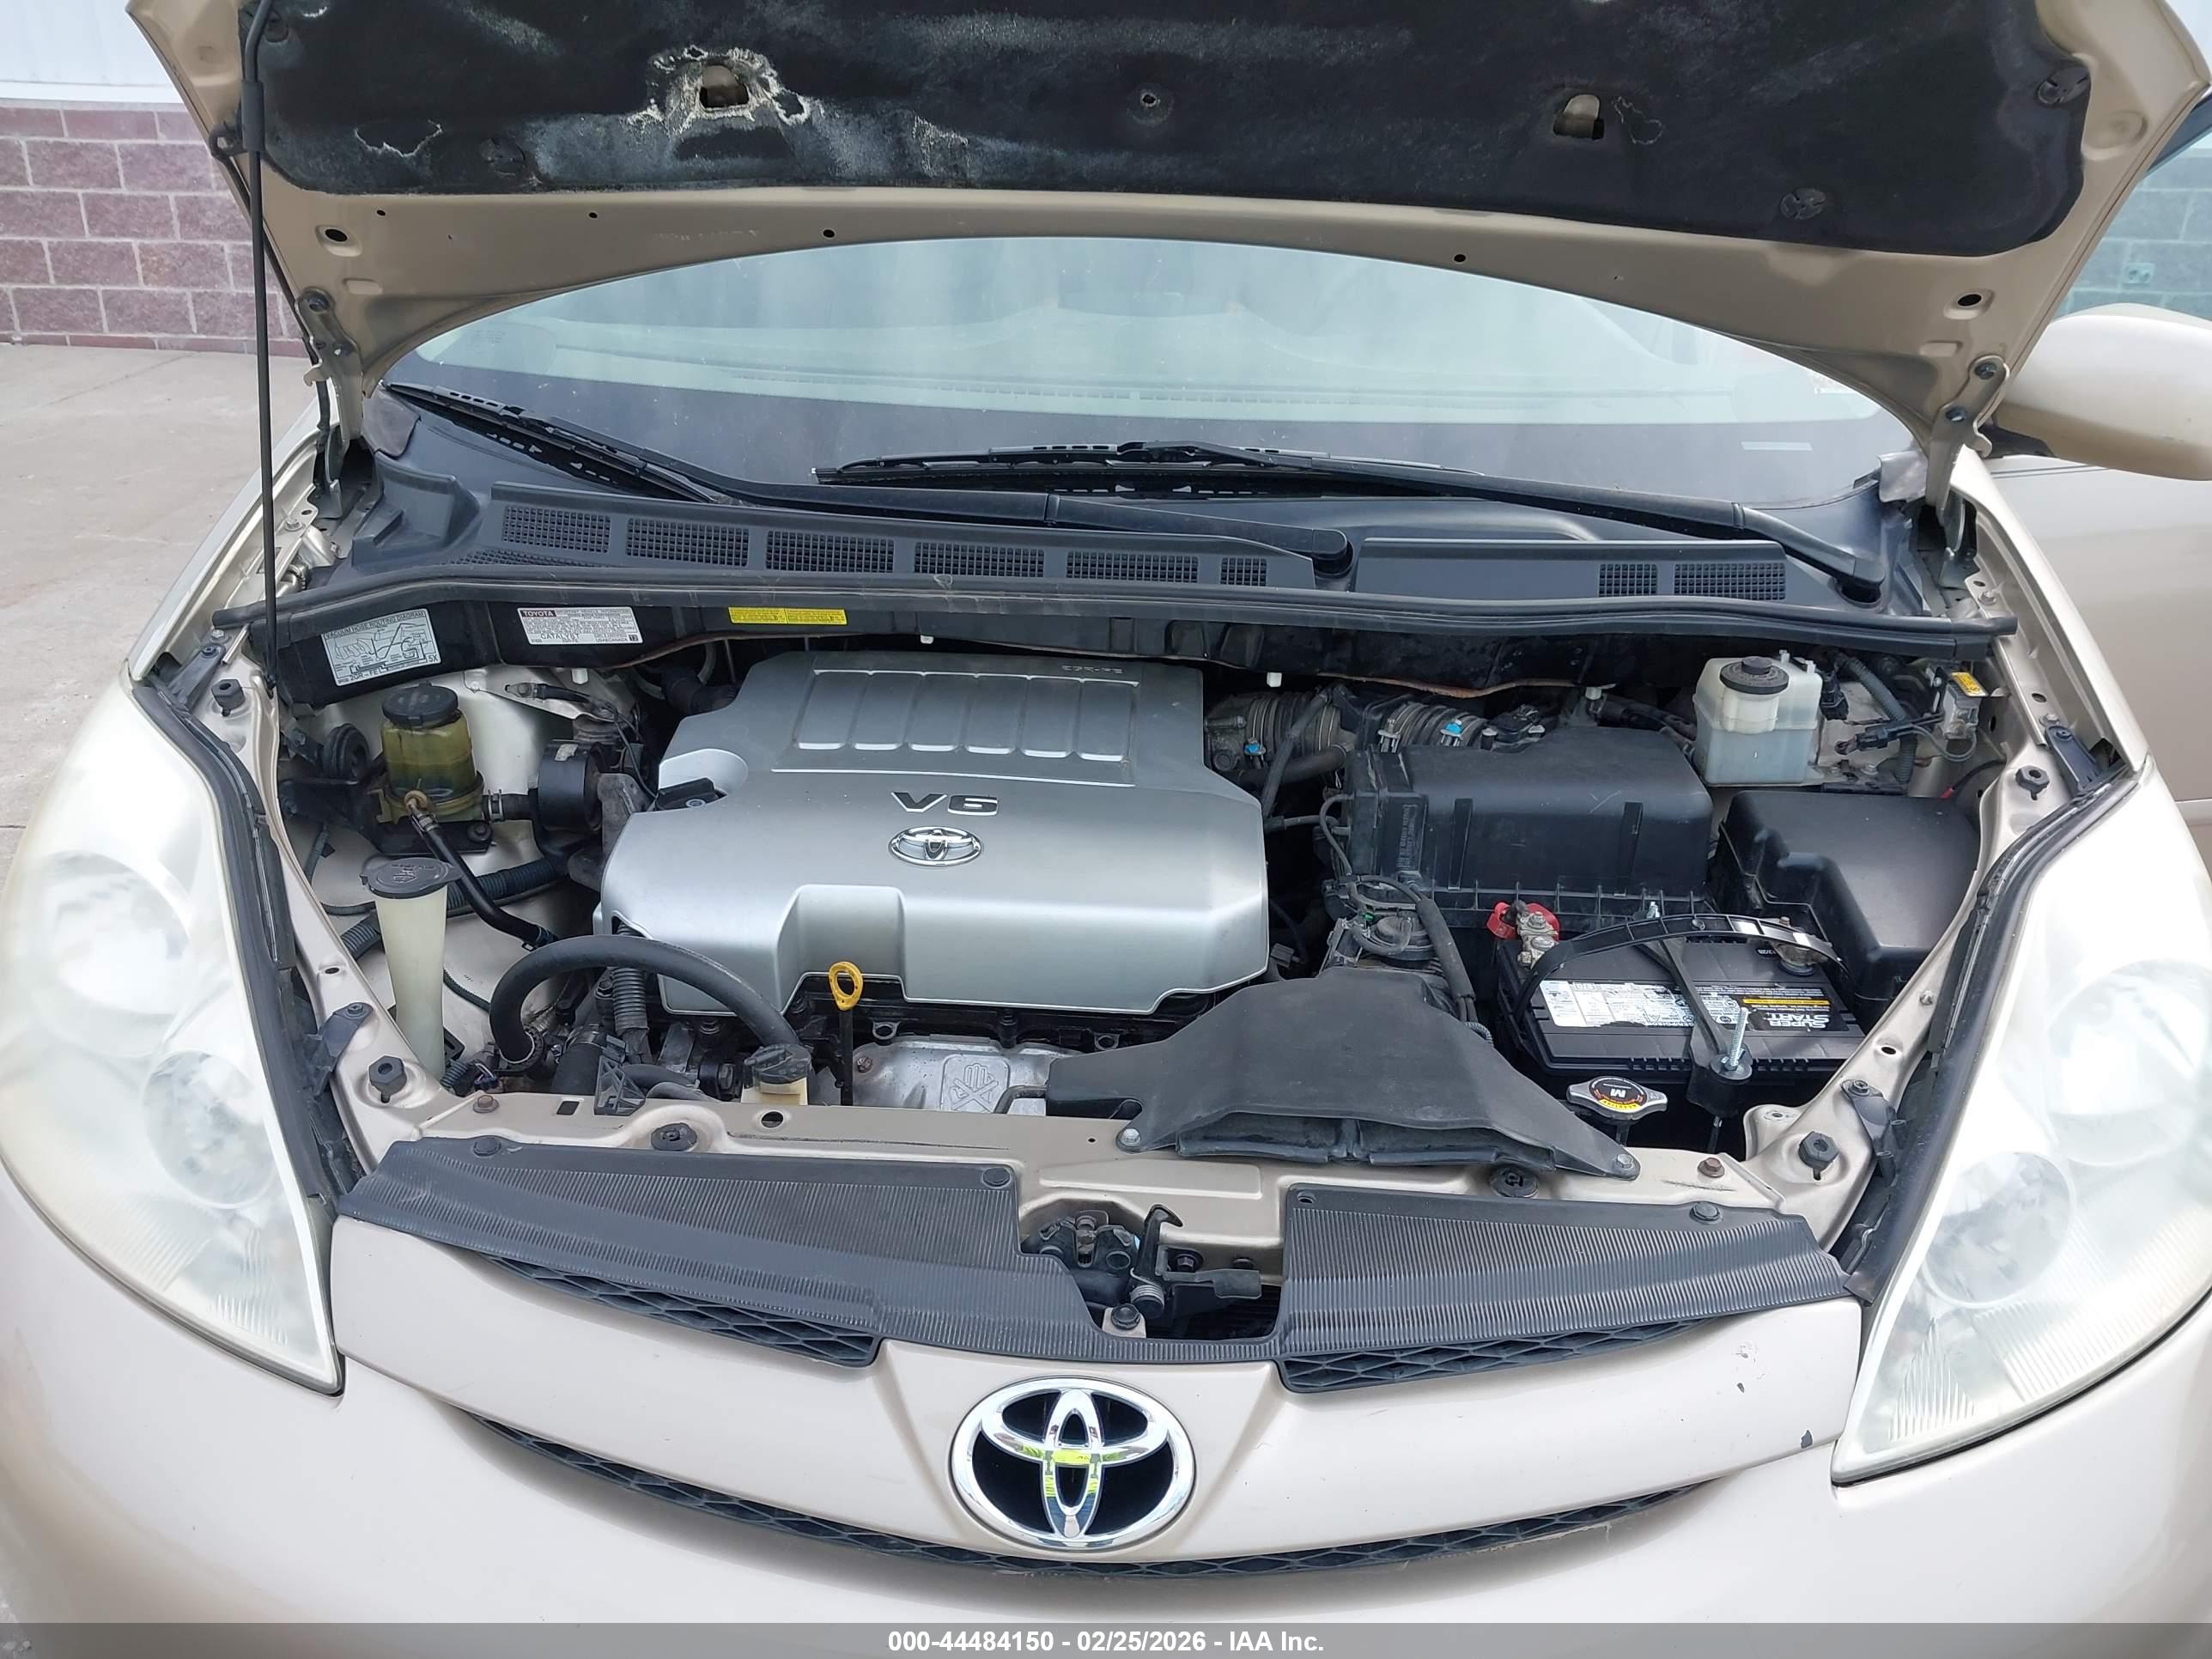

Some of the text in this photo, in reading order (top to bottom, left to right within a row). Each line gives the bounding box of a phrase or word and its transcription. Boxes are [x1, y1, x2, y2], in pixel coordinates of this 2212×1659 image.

[890, 792, 998, 816] V6
[1769, 1013, 1830, 1023] START
[1769, 1019, 1826, 1029] SUPER
